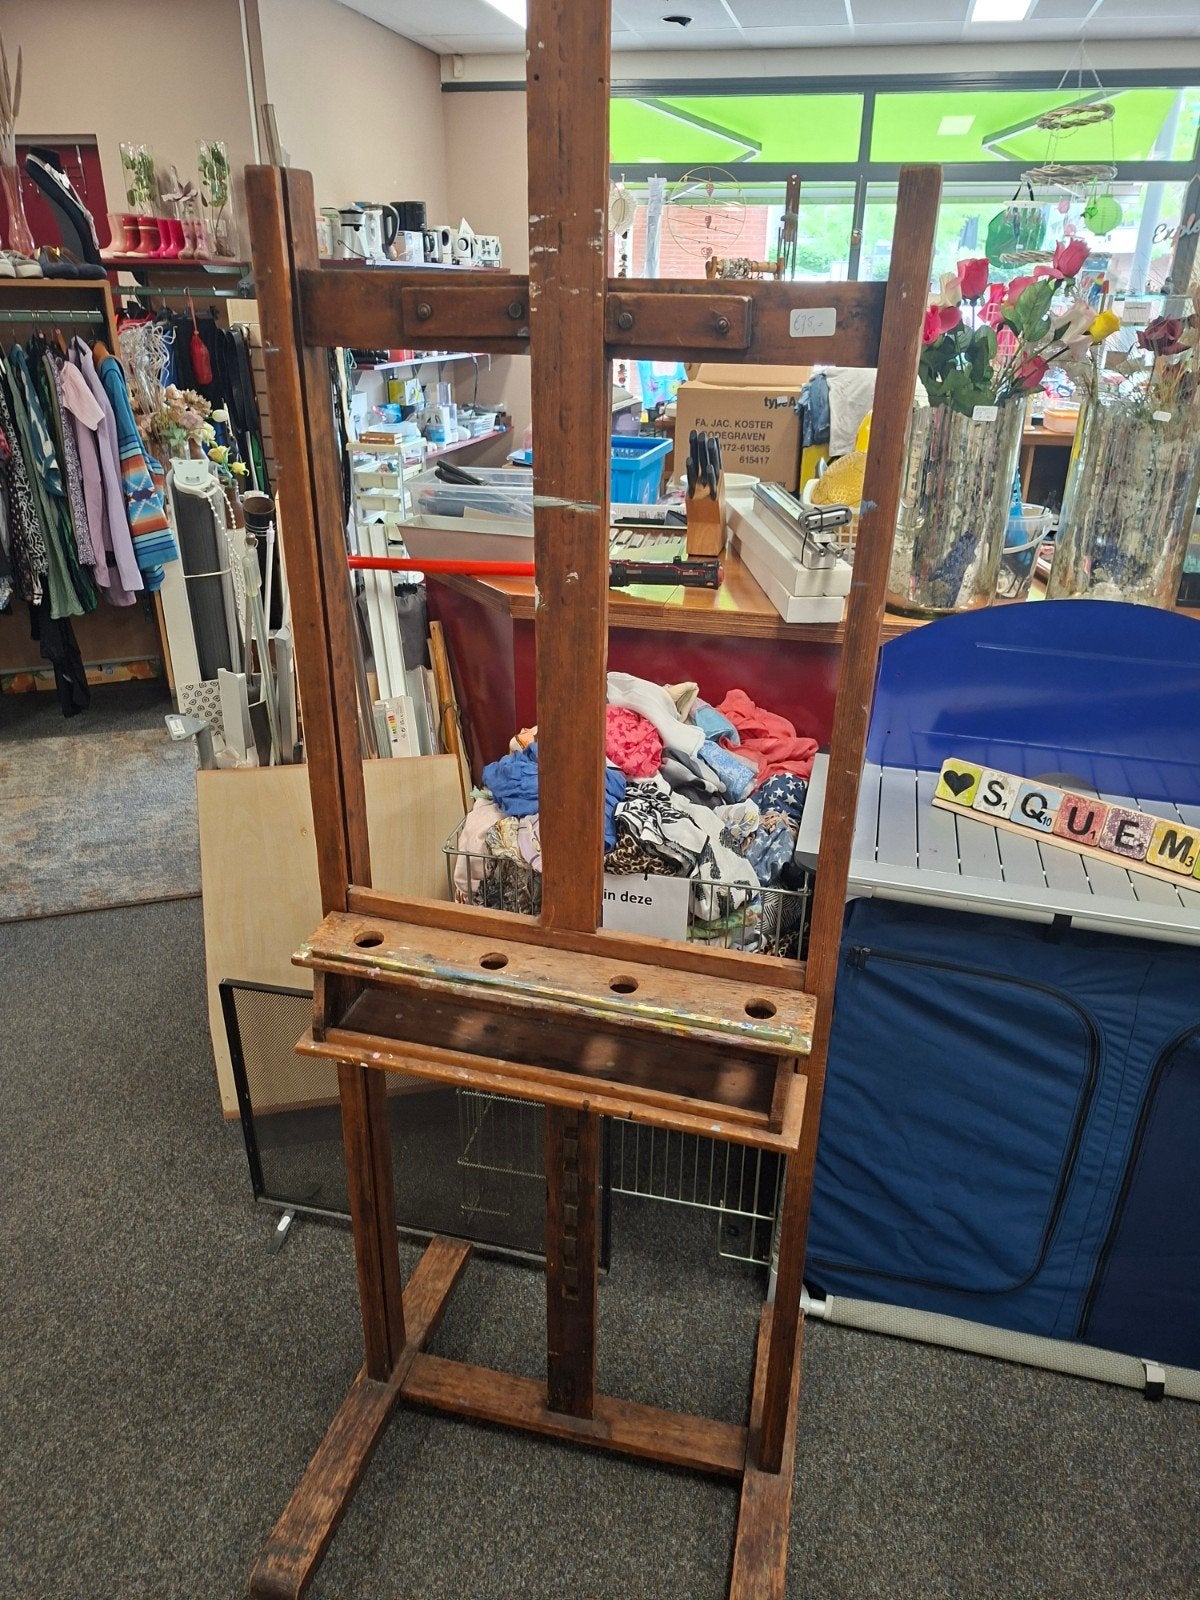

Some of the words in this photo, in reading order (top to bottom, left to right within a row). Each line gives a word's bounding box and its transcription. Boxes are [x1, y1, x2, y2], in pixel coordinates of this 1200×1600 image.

[695, 419, 708, 427] FA.
[711, 420, 732, 428] JAC.
[735, 420, 773, 429] KOSTER
[719, 443, 771, 453] 172-613635
[739, 456, 769, 464] 615417
[604, 888, 616, 900] in
[620, 891, 653, 905] deze
